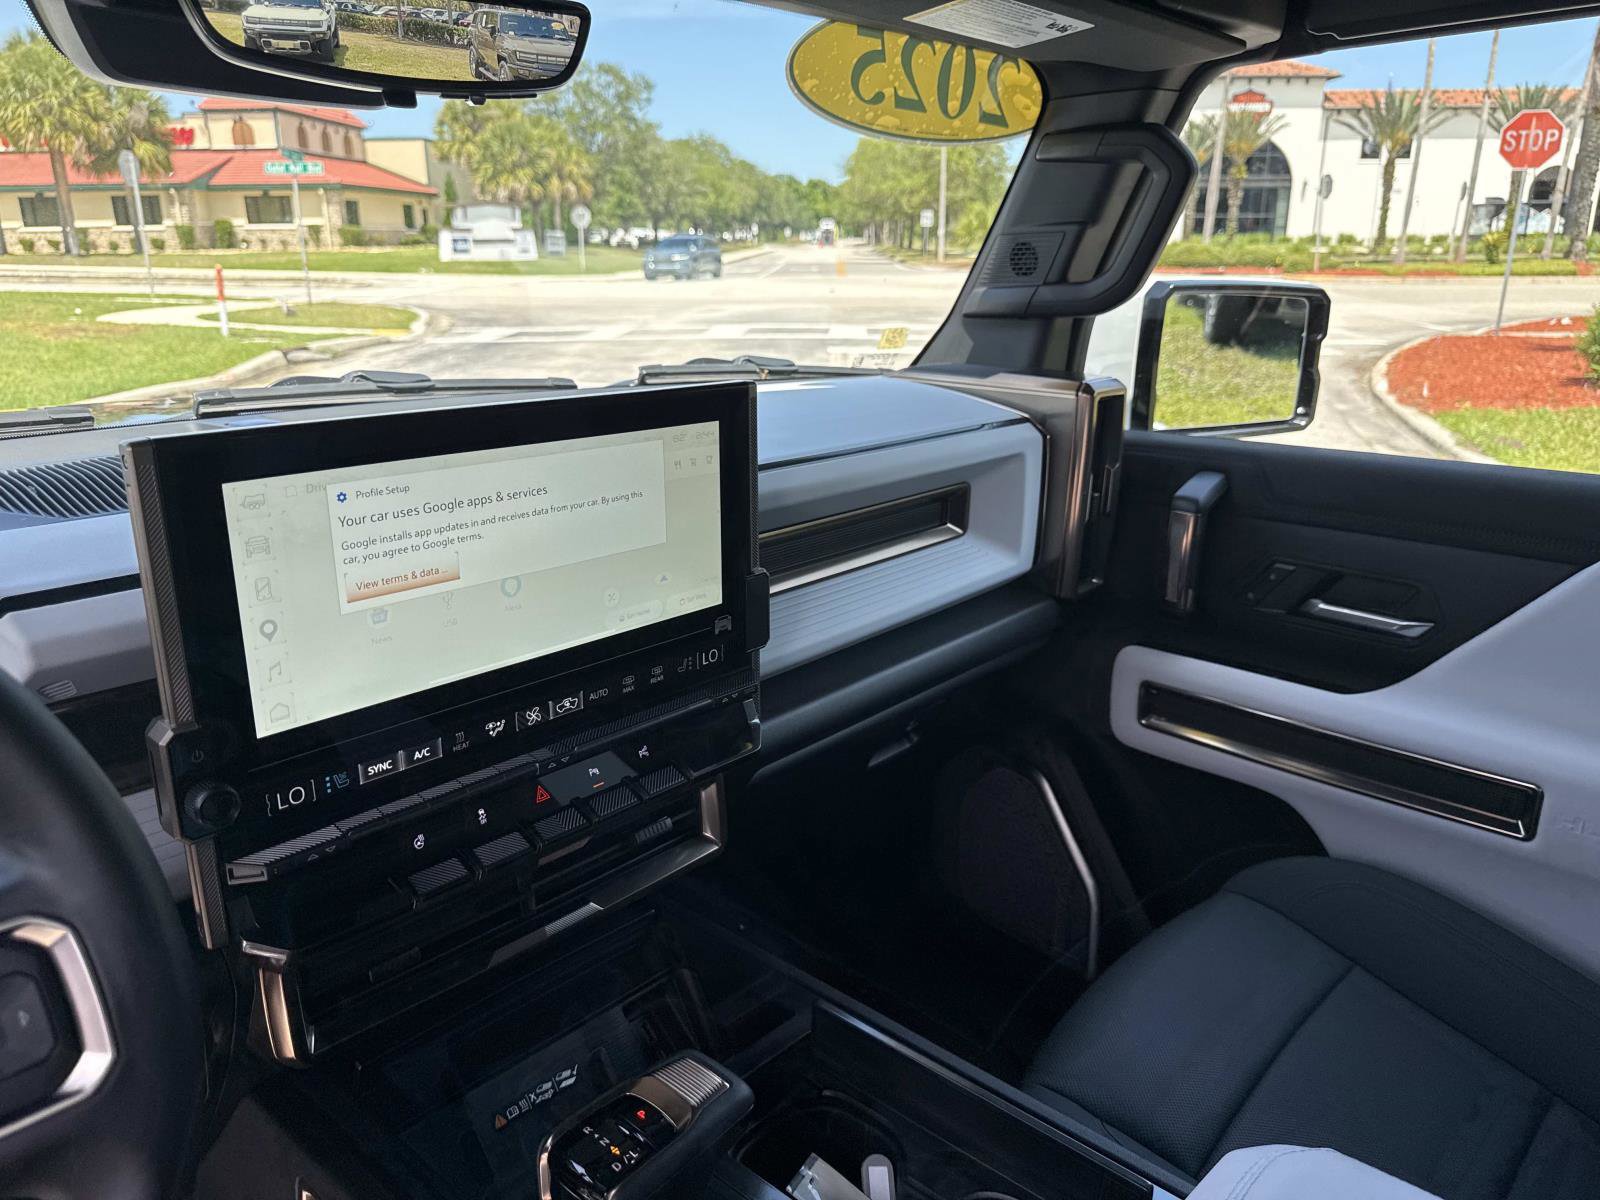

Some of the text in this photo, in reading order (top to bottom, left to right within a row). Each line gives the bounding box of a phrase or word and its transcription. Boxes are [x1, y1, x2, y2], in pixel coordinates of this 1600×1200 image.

[1504, 129, 1559, 152] STOP
[355, 484, 410, 500] Profile Setup
[338, 486, 548, 528] Your car uses Google apps & services
[341, 490, 644, 552] Google installs app updates in and receives data from your car. By using this
[343, 532, 485, 566] car, you agree to Google terms.
[355, 580, 379, 591] View
[382, 574, 409, 586] terms
[411, 570, 419, 580] &
[419, 567, 440, 578] data
[702, 648, 719, 665] LO
[589, 688, 609, 701] AUTO
[622, 685, 635, 694] MAX
[413, 747, 431, 760] A/C
[453, 740, 470, 752] HEAT
[367, 759, 393, 776] SYNC
[276, 786, 305, 810] LO
[636, 1110, 646, 1119] P
[582, 1126, 594, 1134] R
[599, 1137, 610, 1147] N
